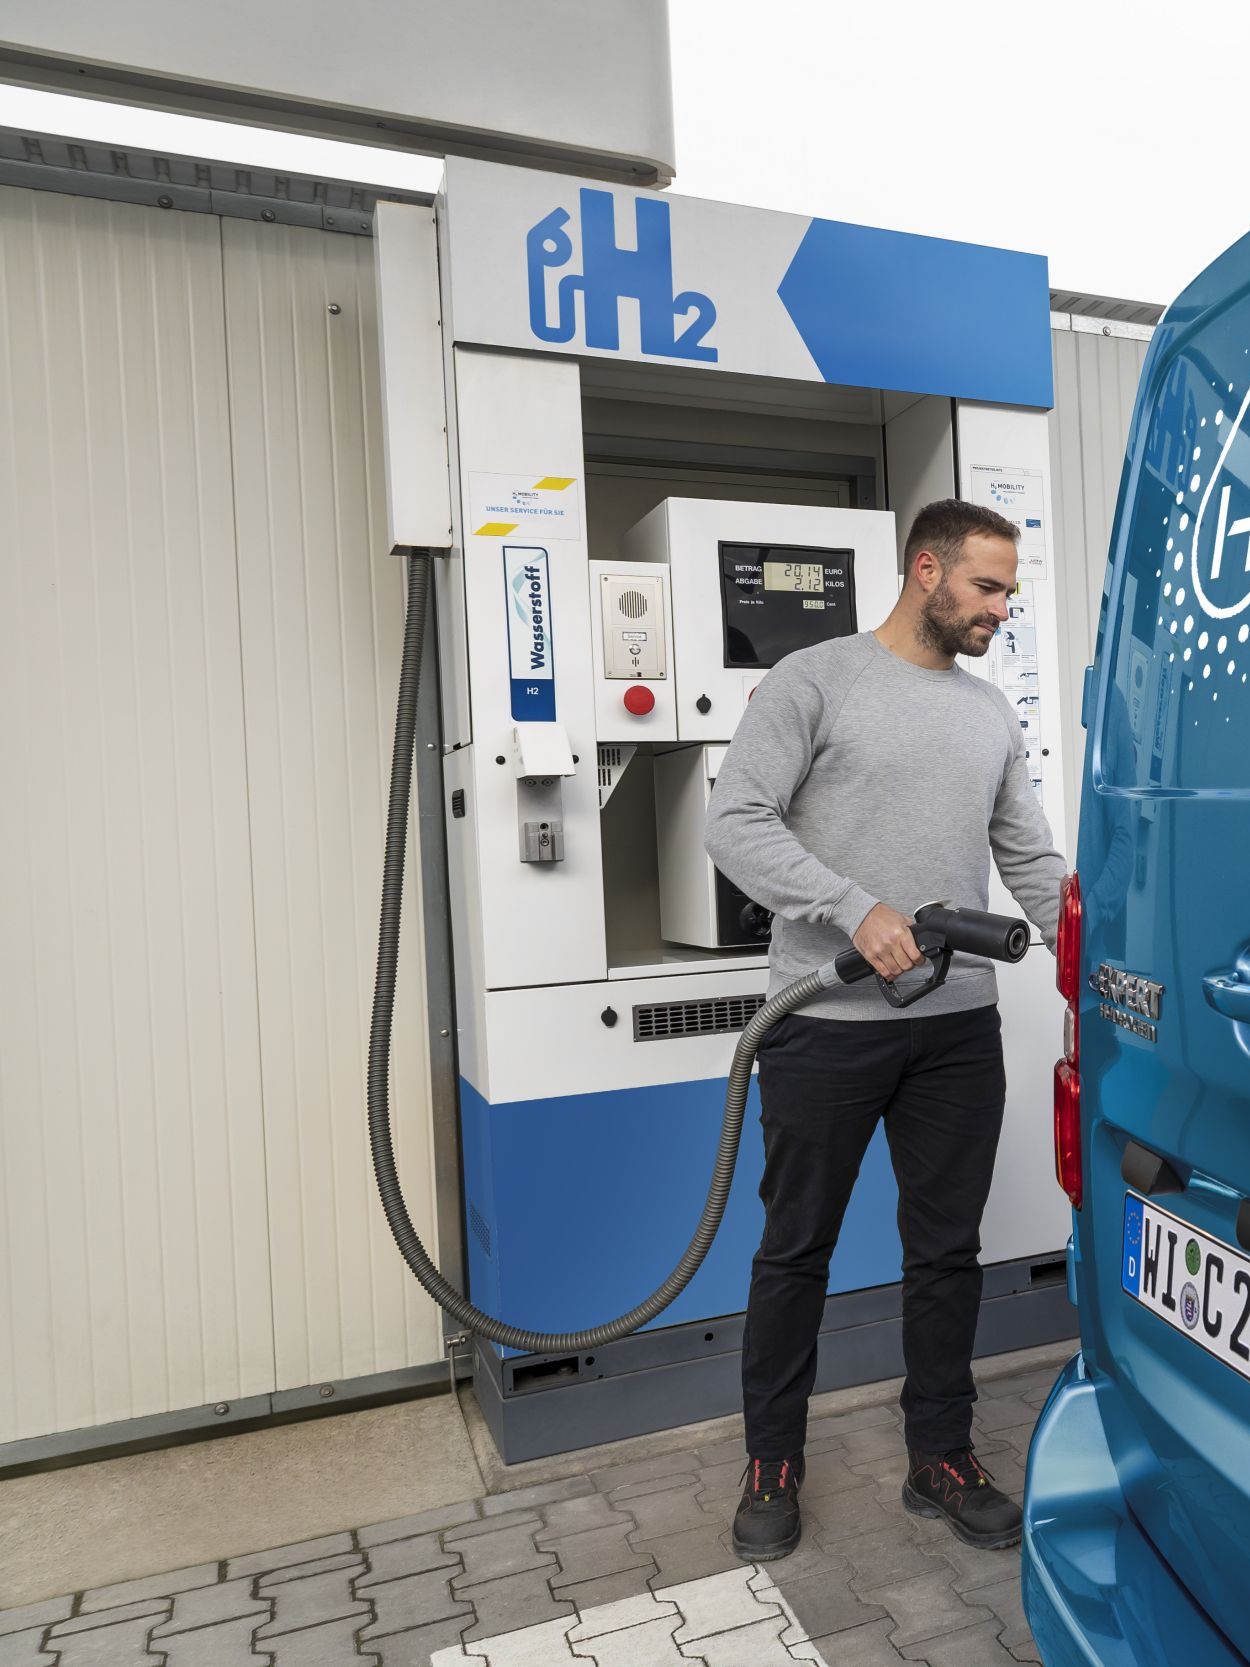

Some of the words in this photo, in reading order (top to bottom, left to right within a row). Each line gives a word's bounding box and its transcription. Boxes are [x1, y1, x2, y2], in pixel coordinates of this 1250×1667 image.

[998, 483, 1025, 491] MOBILITY
[735, 564, 762, 572] BETRAG
[794, 577, 821, 591] 2.12
[825, 580, 845, 588] KILOS
[524, 566, 545, 670] Wasserstoff
[526, 687, 539, 695] H2
[1129, 1255, 1136, 1278] D
[1143, 1217, 1178, 1312] WI
[1202, 1252, 1224, 1338] C
